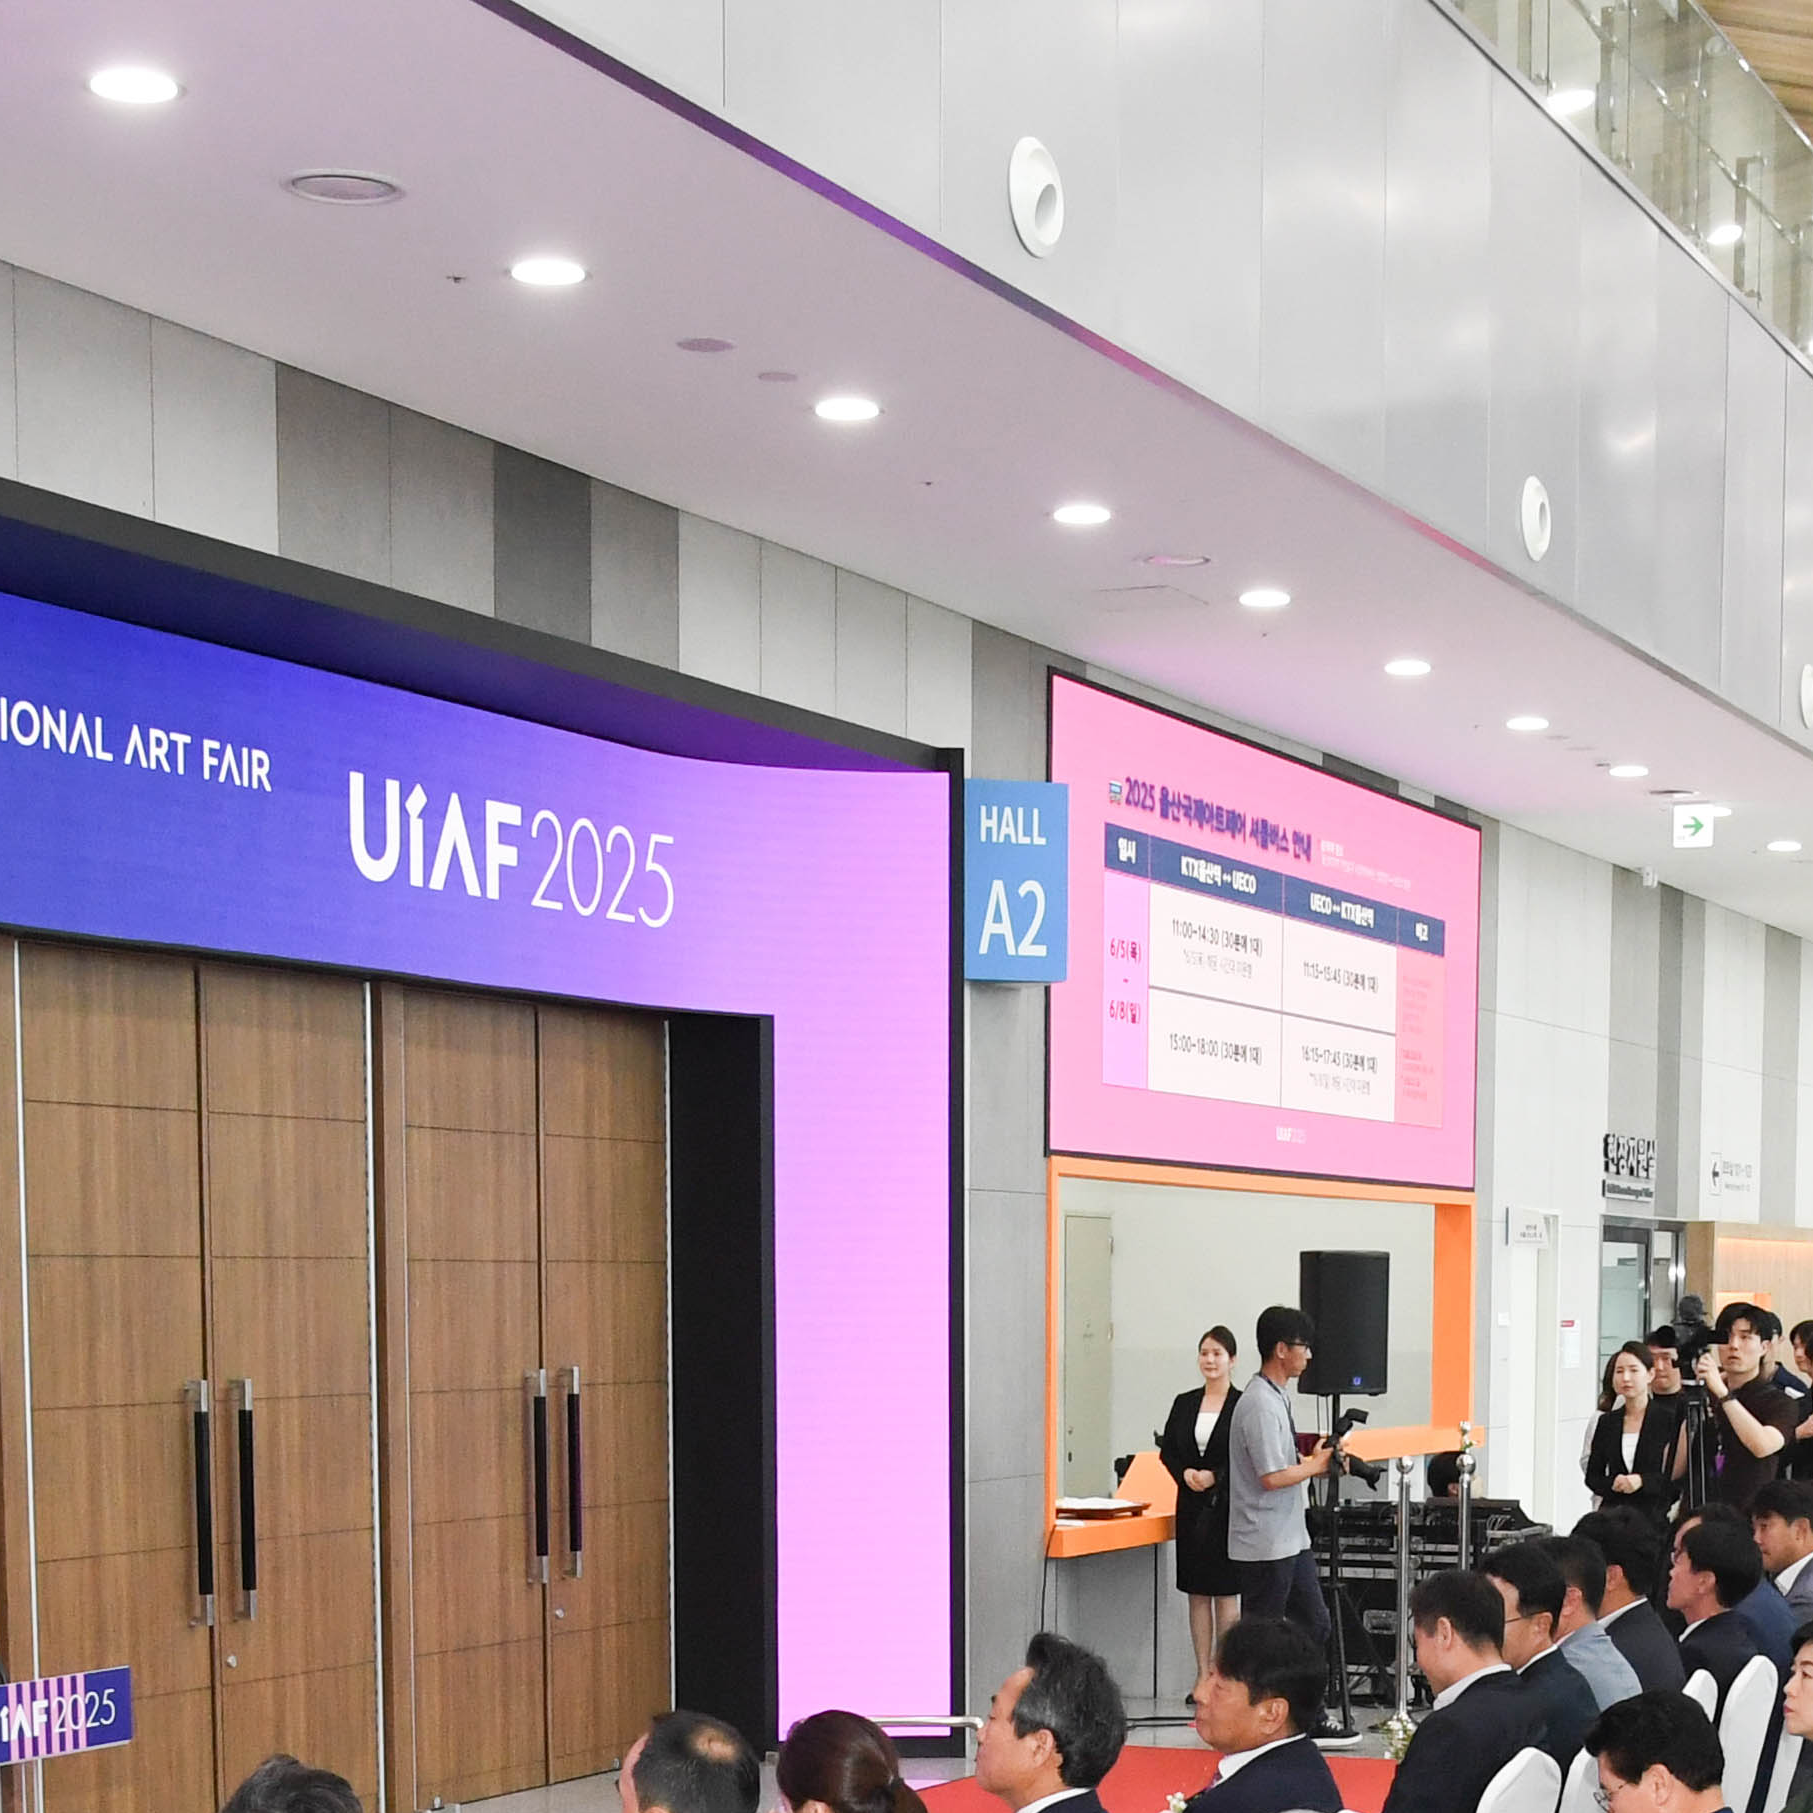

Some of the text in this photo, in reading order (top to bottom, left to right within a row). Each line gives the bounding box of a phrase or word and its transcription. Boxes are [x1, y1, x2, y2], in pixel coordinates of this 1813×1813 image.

[124, 724, 192, 775] ART
[202, 739, 272, 792] FAIR
[1125, 776, 1156, 812] 2025
[980, 805, 1047, 846] HALL
[530, 810, 675, 928] 2025
[978, 879, 1048, 958] A2
[52, 1688, 116, 1733] 2025
